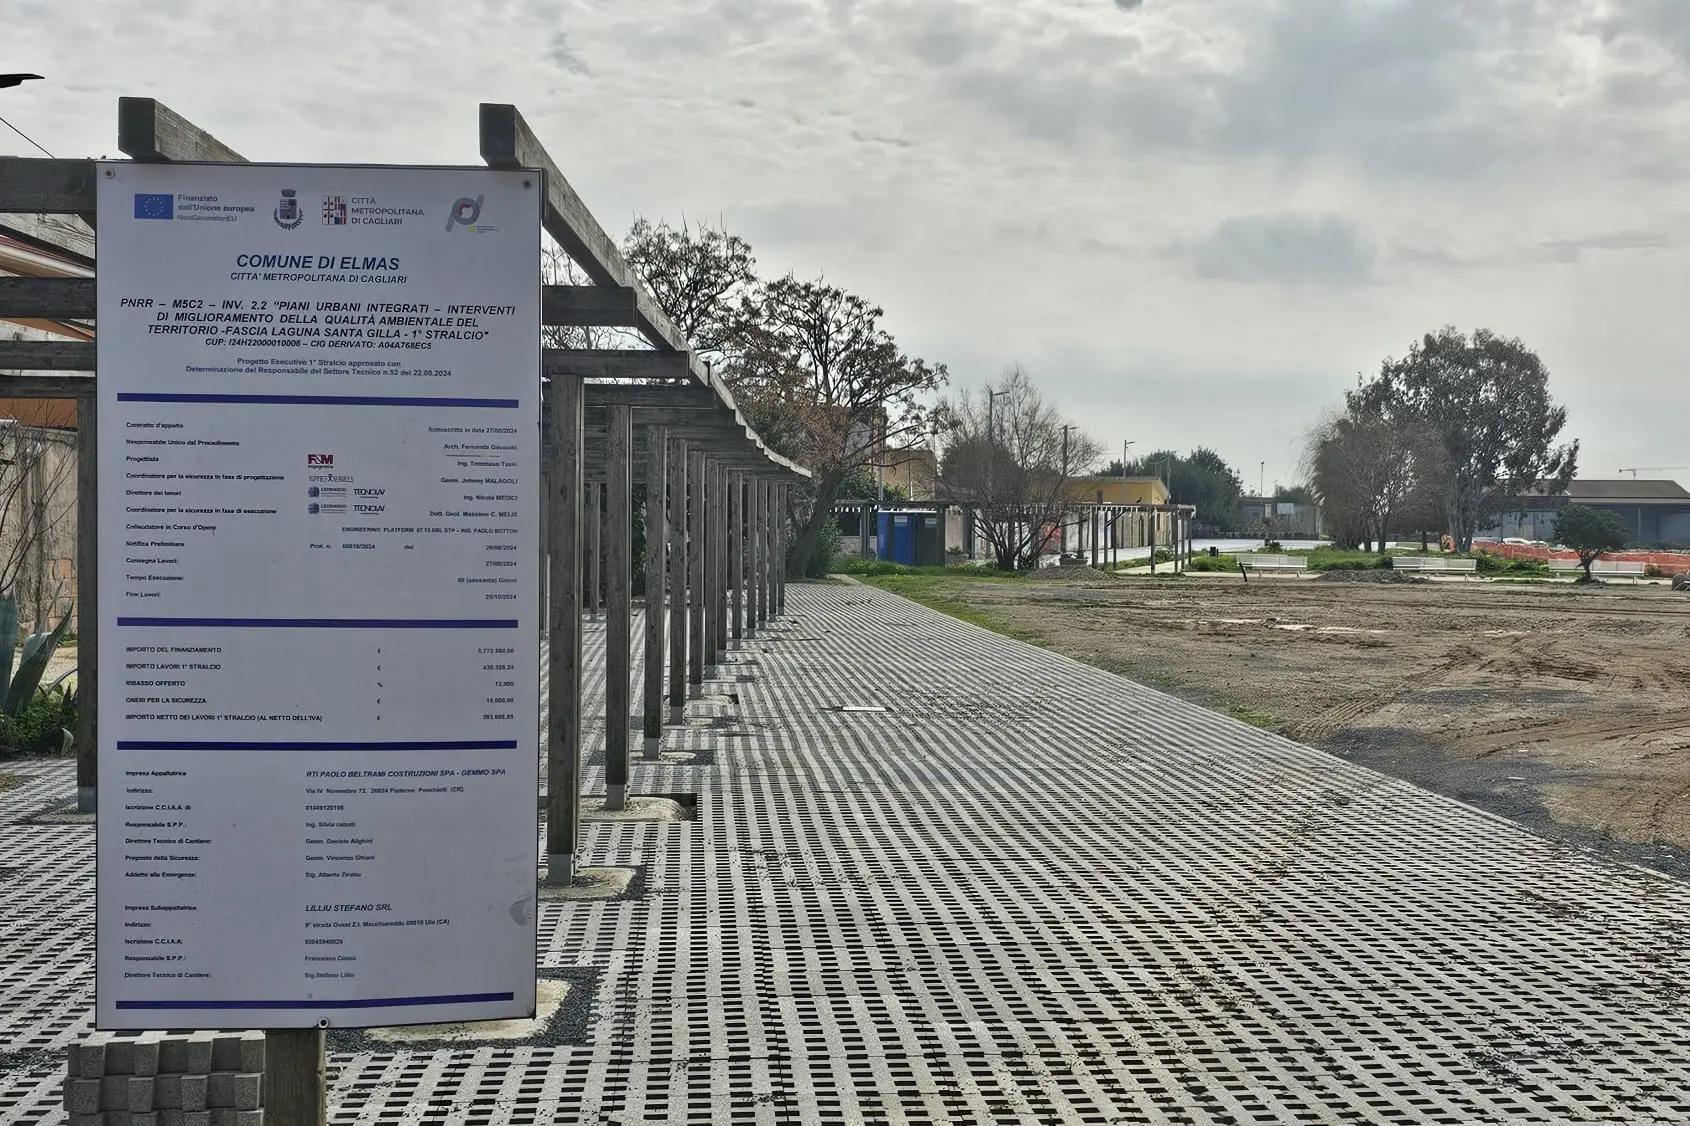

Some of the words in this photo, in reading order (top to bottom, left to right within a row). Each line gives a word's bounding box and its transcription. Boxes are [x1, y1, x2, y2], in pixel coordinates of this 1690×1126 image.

[177, 194, 218, 202] Finanziato
[351, 195, 376, 205] CITTÀ
[177, 203, 221, 211] dall'Unione
[222, 205, 255, 213] europea
[351, 207, 424, 216] METROPOLITANA
[362, 217, 402, 225] CAGLIARI
[235, 254, 314, 269] COMUNE
[317, 255, 335, 269] DI
[339, 256, 401, 270] ELMAS
[262, 272, 347, 282] METROPOLITANA
[348, 274, 359, 282] DI
[359, 274, 407, 284] CAGLIARI
[119, 298, 154, 308] PNRR
[171, 299, 204, 309] M5C2
[221, 299, 245, 310] INV.
[250, 300, 268, 310] 2.2
[315, 301, 361, 312] URBANI
[365, 302, 429, 312] INTEGRATI
[446, 304, 515, 315] INTERVENTI
[156, 311, 169, 321] DI
[174, 312, 274, 323] MIGLIORAMENTO
[279, 314, 319, 324] DELLA
[323, 313, 377, 325] QUALITÀ
[377, 316, 454, 326] AMBIENTALE
[455, 317, 480, 327] DEL
[145, 324, 219, 334] TERRITORIO
[220, 325, 269, 336] -FASCIA
[270, 326, 321, 337] LAGUNA
[323, 327, 364, 337] SANTA
[365, 328, 402, 338] GILLA
[204, 337, 227, 346] CUP:
[327, 339, 376, 348] DERIVATO:
[236, 357, 269, 366] Progetto
[347, 360, 385, 368] approvato
[319, 770, 347, 778] PAOLO
[347, 770, 387, 778] BELTRAMI
[460, 768, 490, 776] GEMMO
[304, 904, 332, 912] LILLIU
[333, 903, 374, 912] STEFANO
[374, 903, 393, 911] SRL
